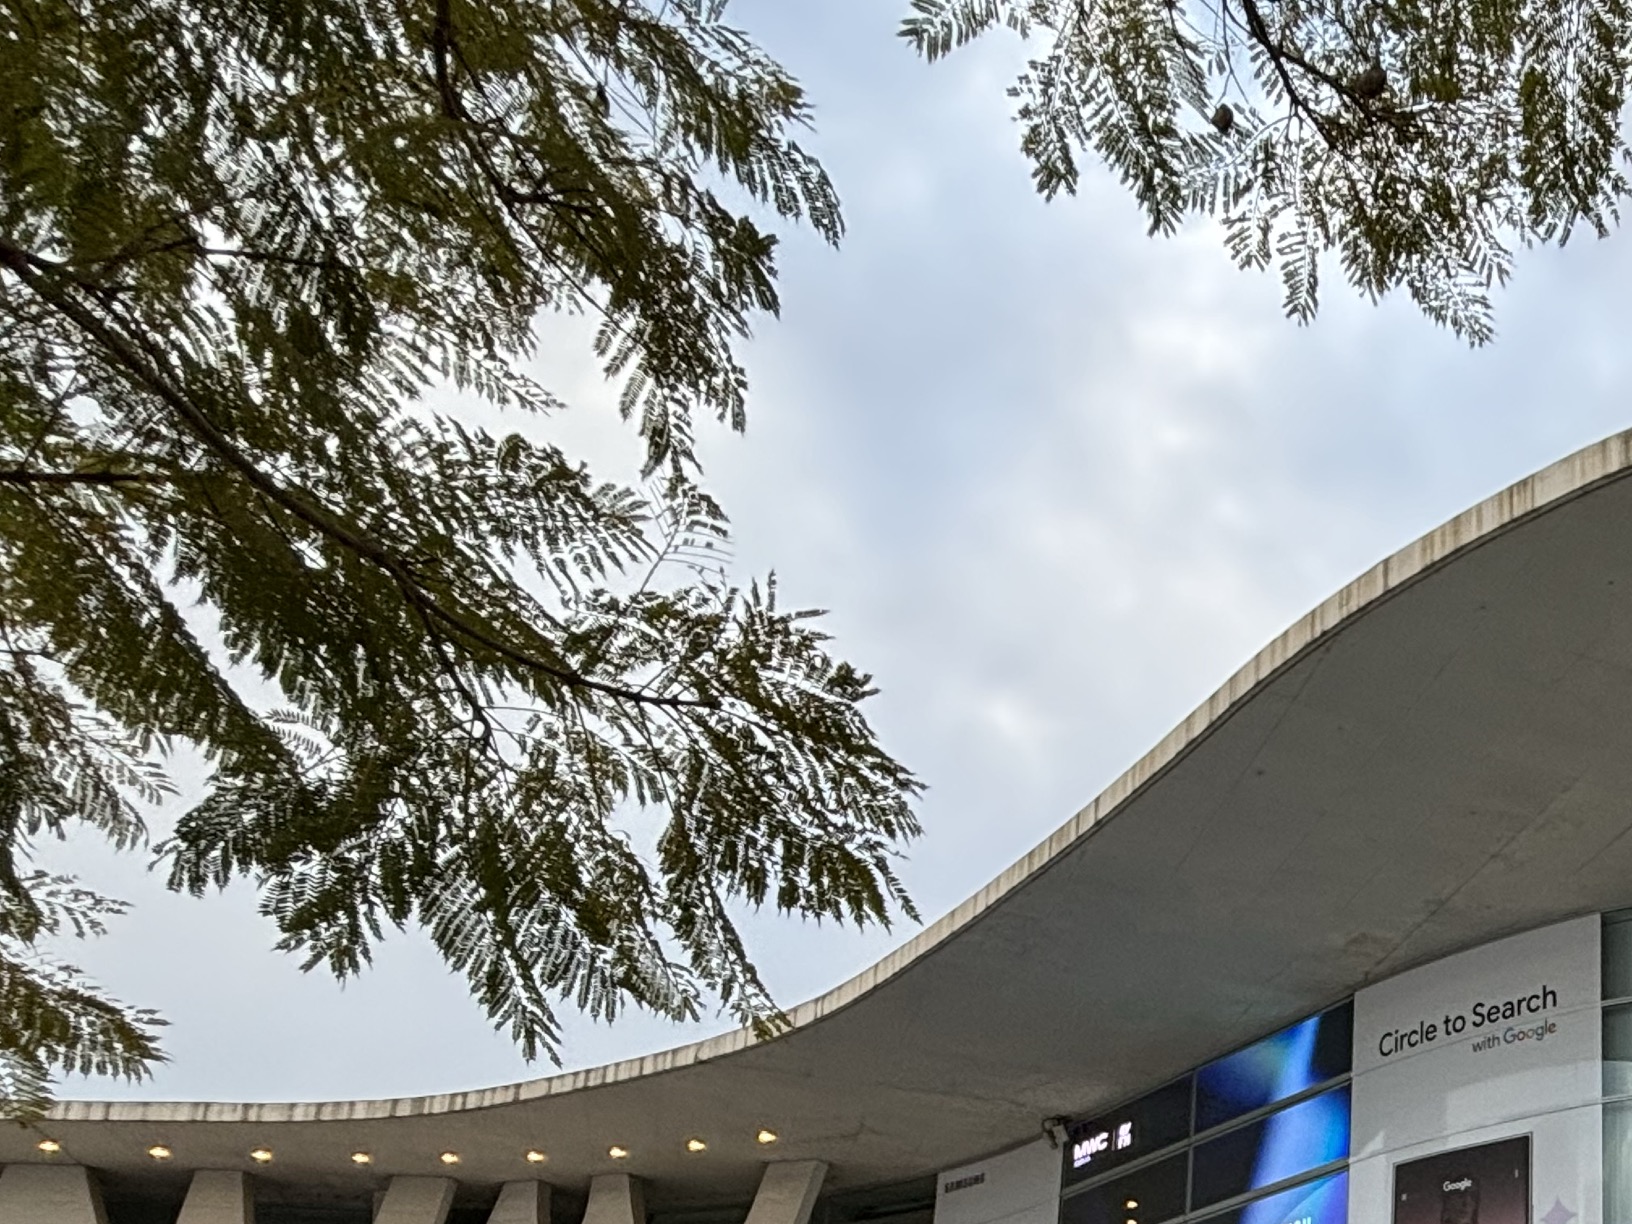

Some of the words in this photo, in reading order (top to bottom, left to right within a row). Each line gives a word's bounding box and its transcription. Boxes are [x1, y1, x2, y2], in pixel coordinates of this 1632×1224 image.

[1379, 1020, 1438, 1057] Circle
[1443, 1013, 1467, 1037] to
[1472, 984, 1559, 1029] Search
[1471, 1034, 1501, 1054] with
[1503, 1018, 1558, 1046] Google
[1073, 1131, 1109, 1161] MWC
[944, 1172, 986, 1194] SAMSUNG
[1442, 1178, 1473, 1192] Google
